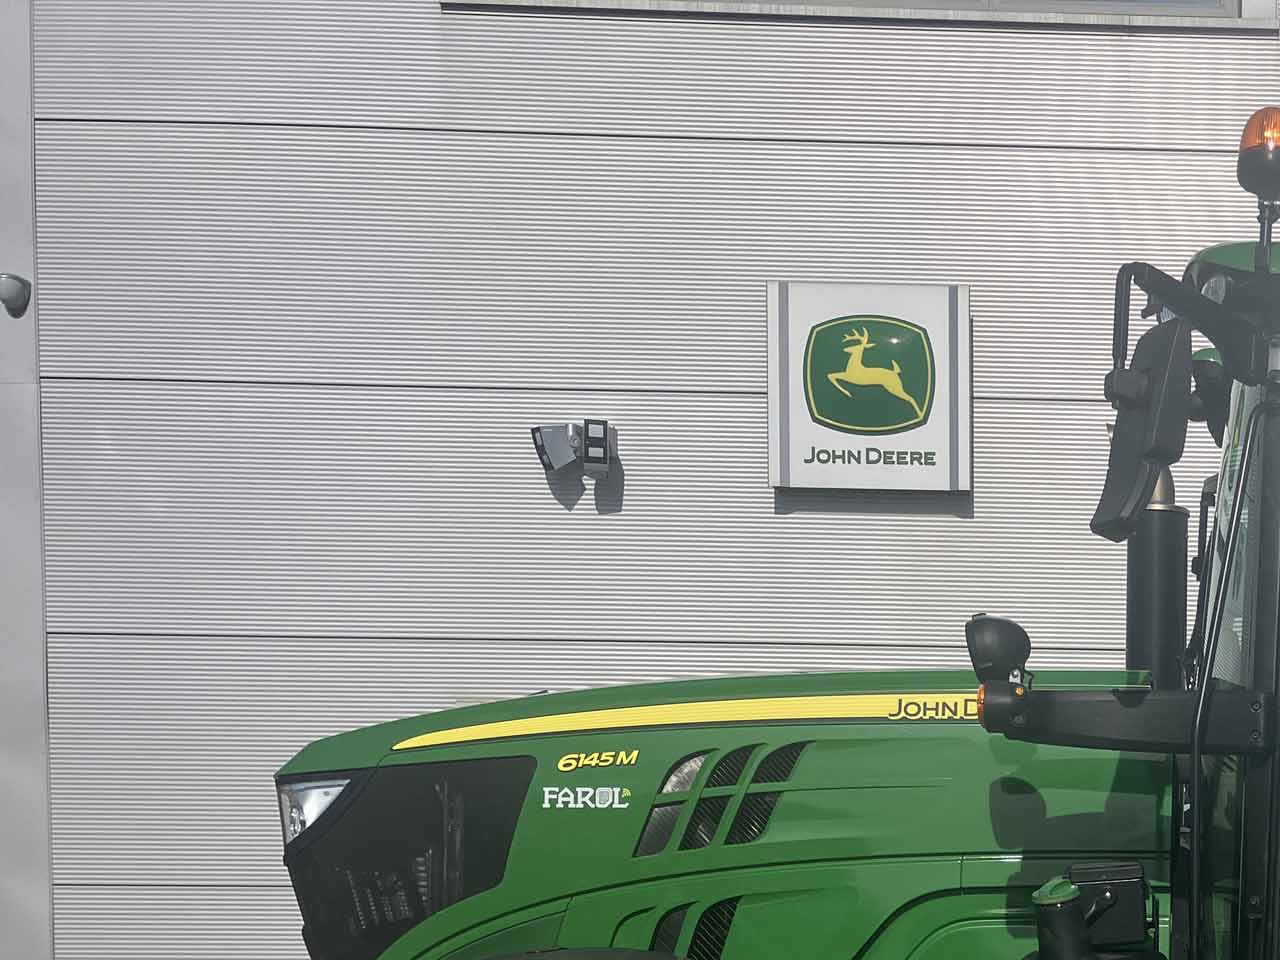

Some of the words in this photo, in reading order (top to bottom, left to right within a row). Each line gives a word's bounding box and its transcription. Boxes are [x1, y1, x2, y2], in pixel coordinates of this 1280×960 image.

[803, 446, 864, 465] JOHN
[866, 447, 936, 466] DEERE
[888, 698, 958, 717] JOHN
[541, 786, 630, 809] FAROL
